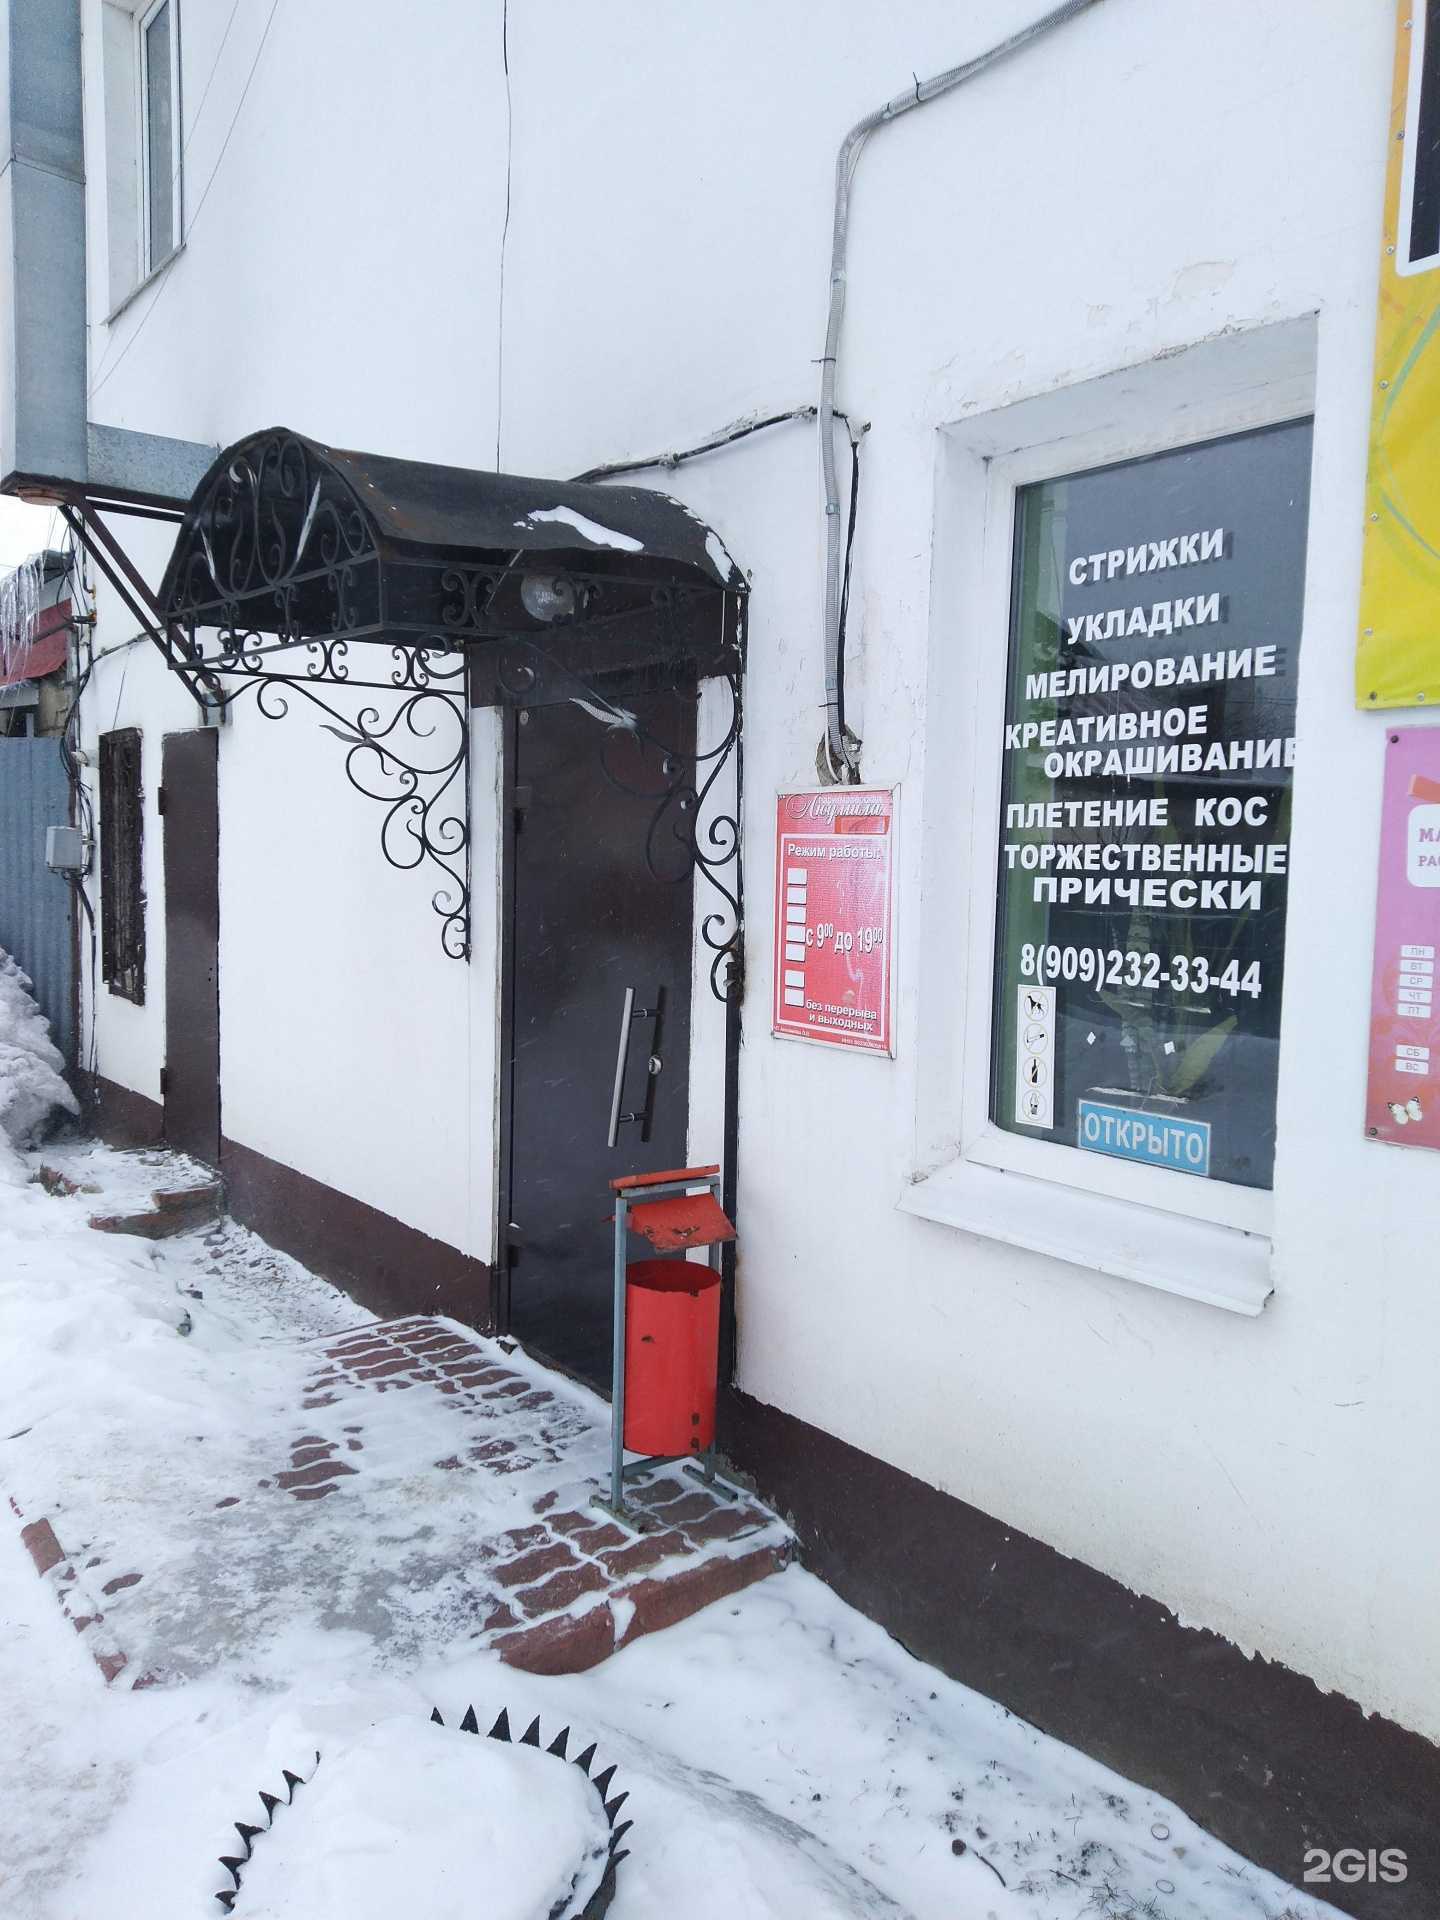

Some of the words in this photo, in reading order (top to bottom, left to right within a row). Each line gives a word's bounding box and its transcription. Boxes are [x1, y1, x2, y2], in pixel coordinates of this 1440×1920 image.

[1068, 528, 1224, 585] СТРИЖКИ
[1067, 593, 1220, 645] УКЛАДКИ
[1025, 645, 1277, 700] МЕЛИРОВАНИЕ
[1005, 705, 1208, 750] КРЕАТИВНОЕ
[1044, 737, 1297, 778] ОКРАШИВАНИЕ
[1006, 798, 1169, 829] ПЛЕТЕНИЕ
[1194, 797, 1268, 827] КОС
[787, 843, 826, 858] Режим
[1004, 844, 1288, 875] ТОРЖЕСТВЕННЫЕ
[1418, 855, 1440, 868] РА
[1033, 877, 1262, 911] ПРИЧЕСКИ
[834, 931, 854, 955] до
[1020, 943, 1263, 999] 8(909)232-33-44
[806, 999, 823, 1012] без
[825, 1003, 877, 1021] перерыва
[809, 1013, 816, 1023] и
[818, 1014, 874, 1033] выходных
[1083, 1113, 1205, 1164] ОТКРЫТО
